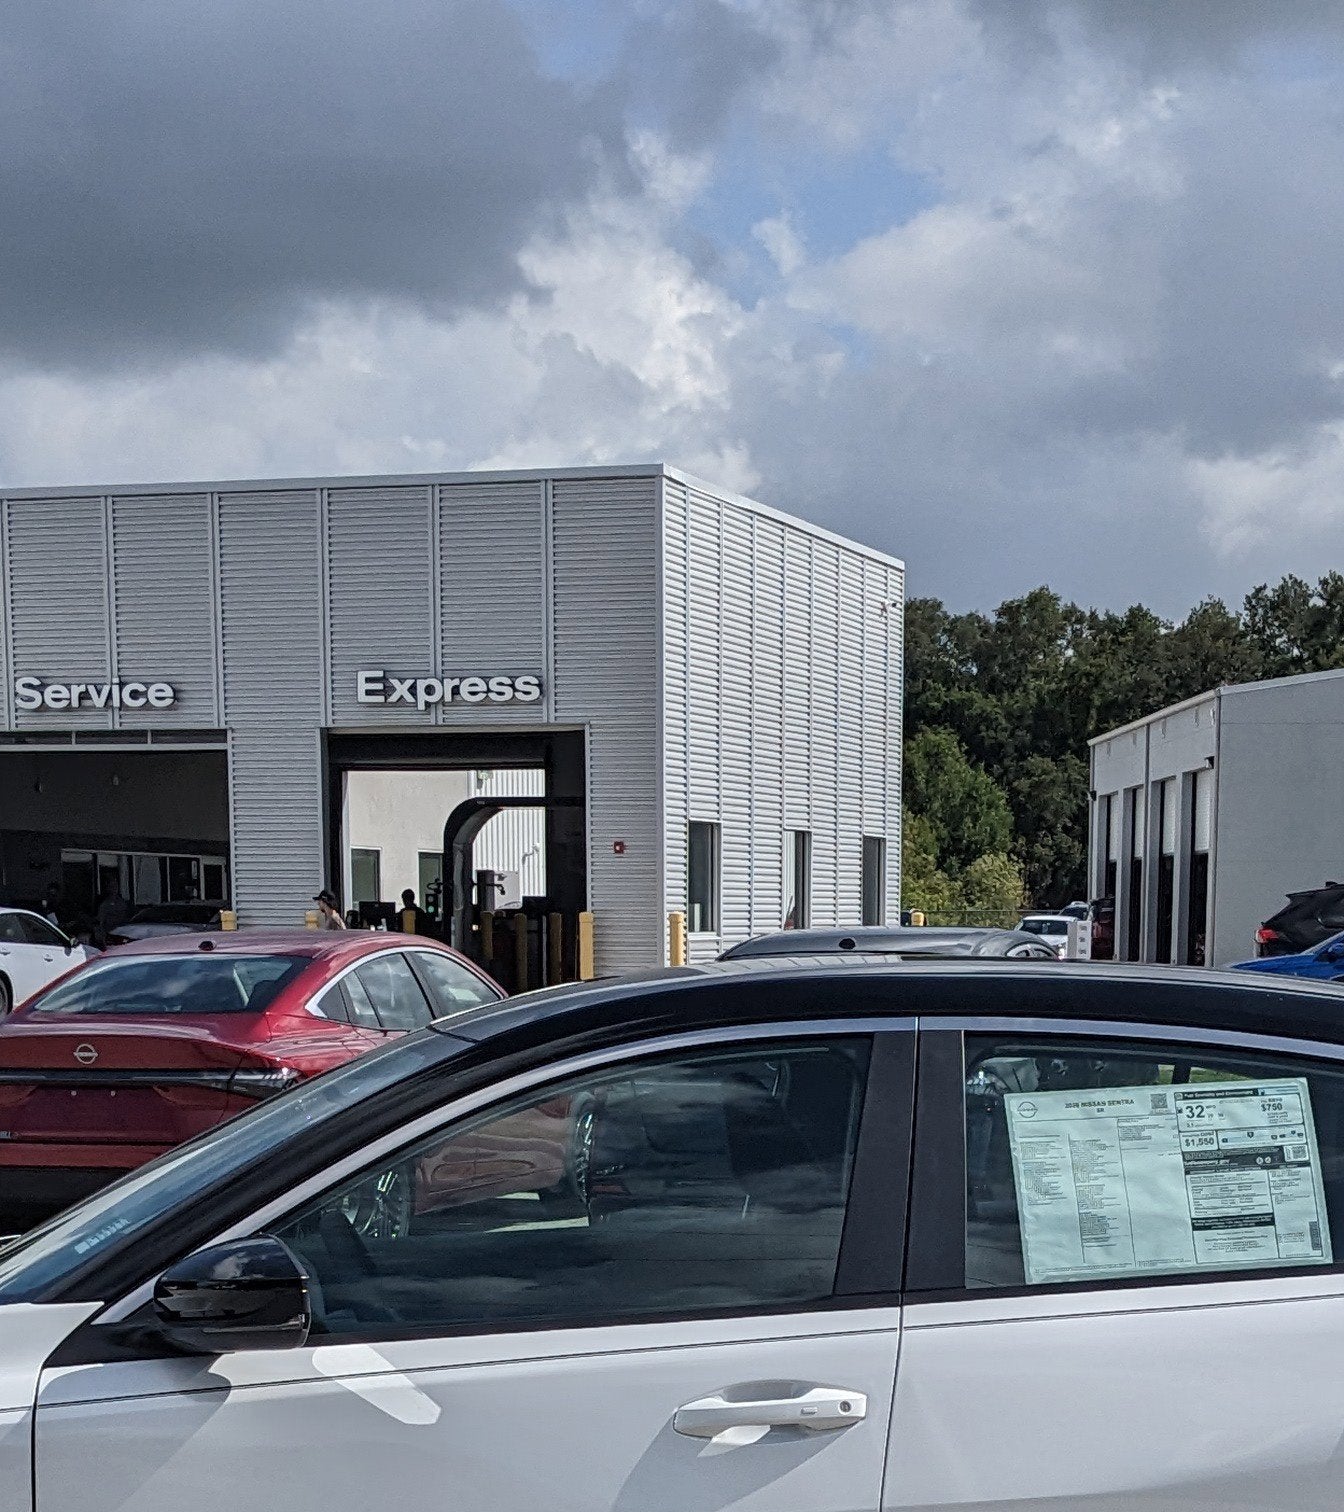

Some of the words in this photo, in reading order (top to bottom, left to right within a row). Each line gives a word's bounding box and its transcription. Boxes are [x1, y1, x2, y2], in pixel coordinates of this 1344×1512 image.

[14, 677, 177, 709] Service
[357, 670, 543, 711] Express
[1185, 1105, 1205, 1118] 32
[1261, 1103, 1282, 1111] $750
